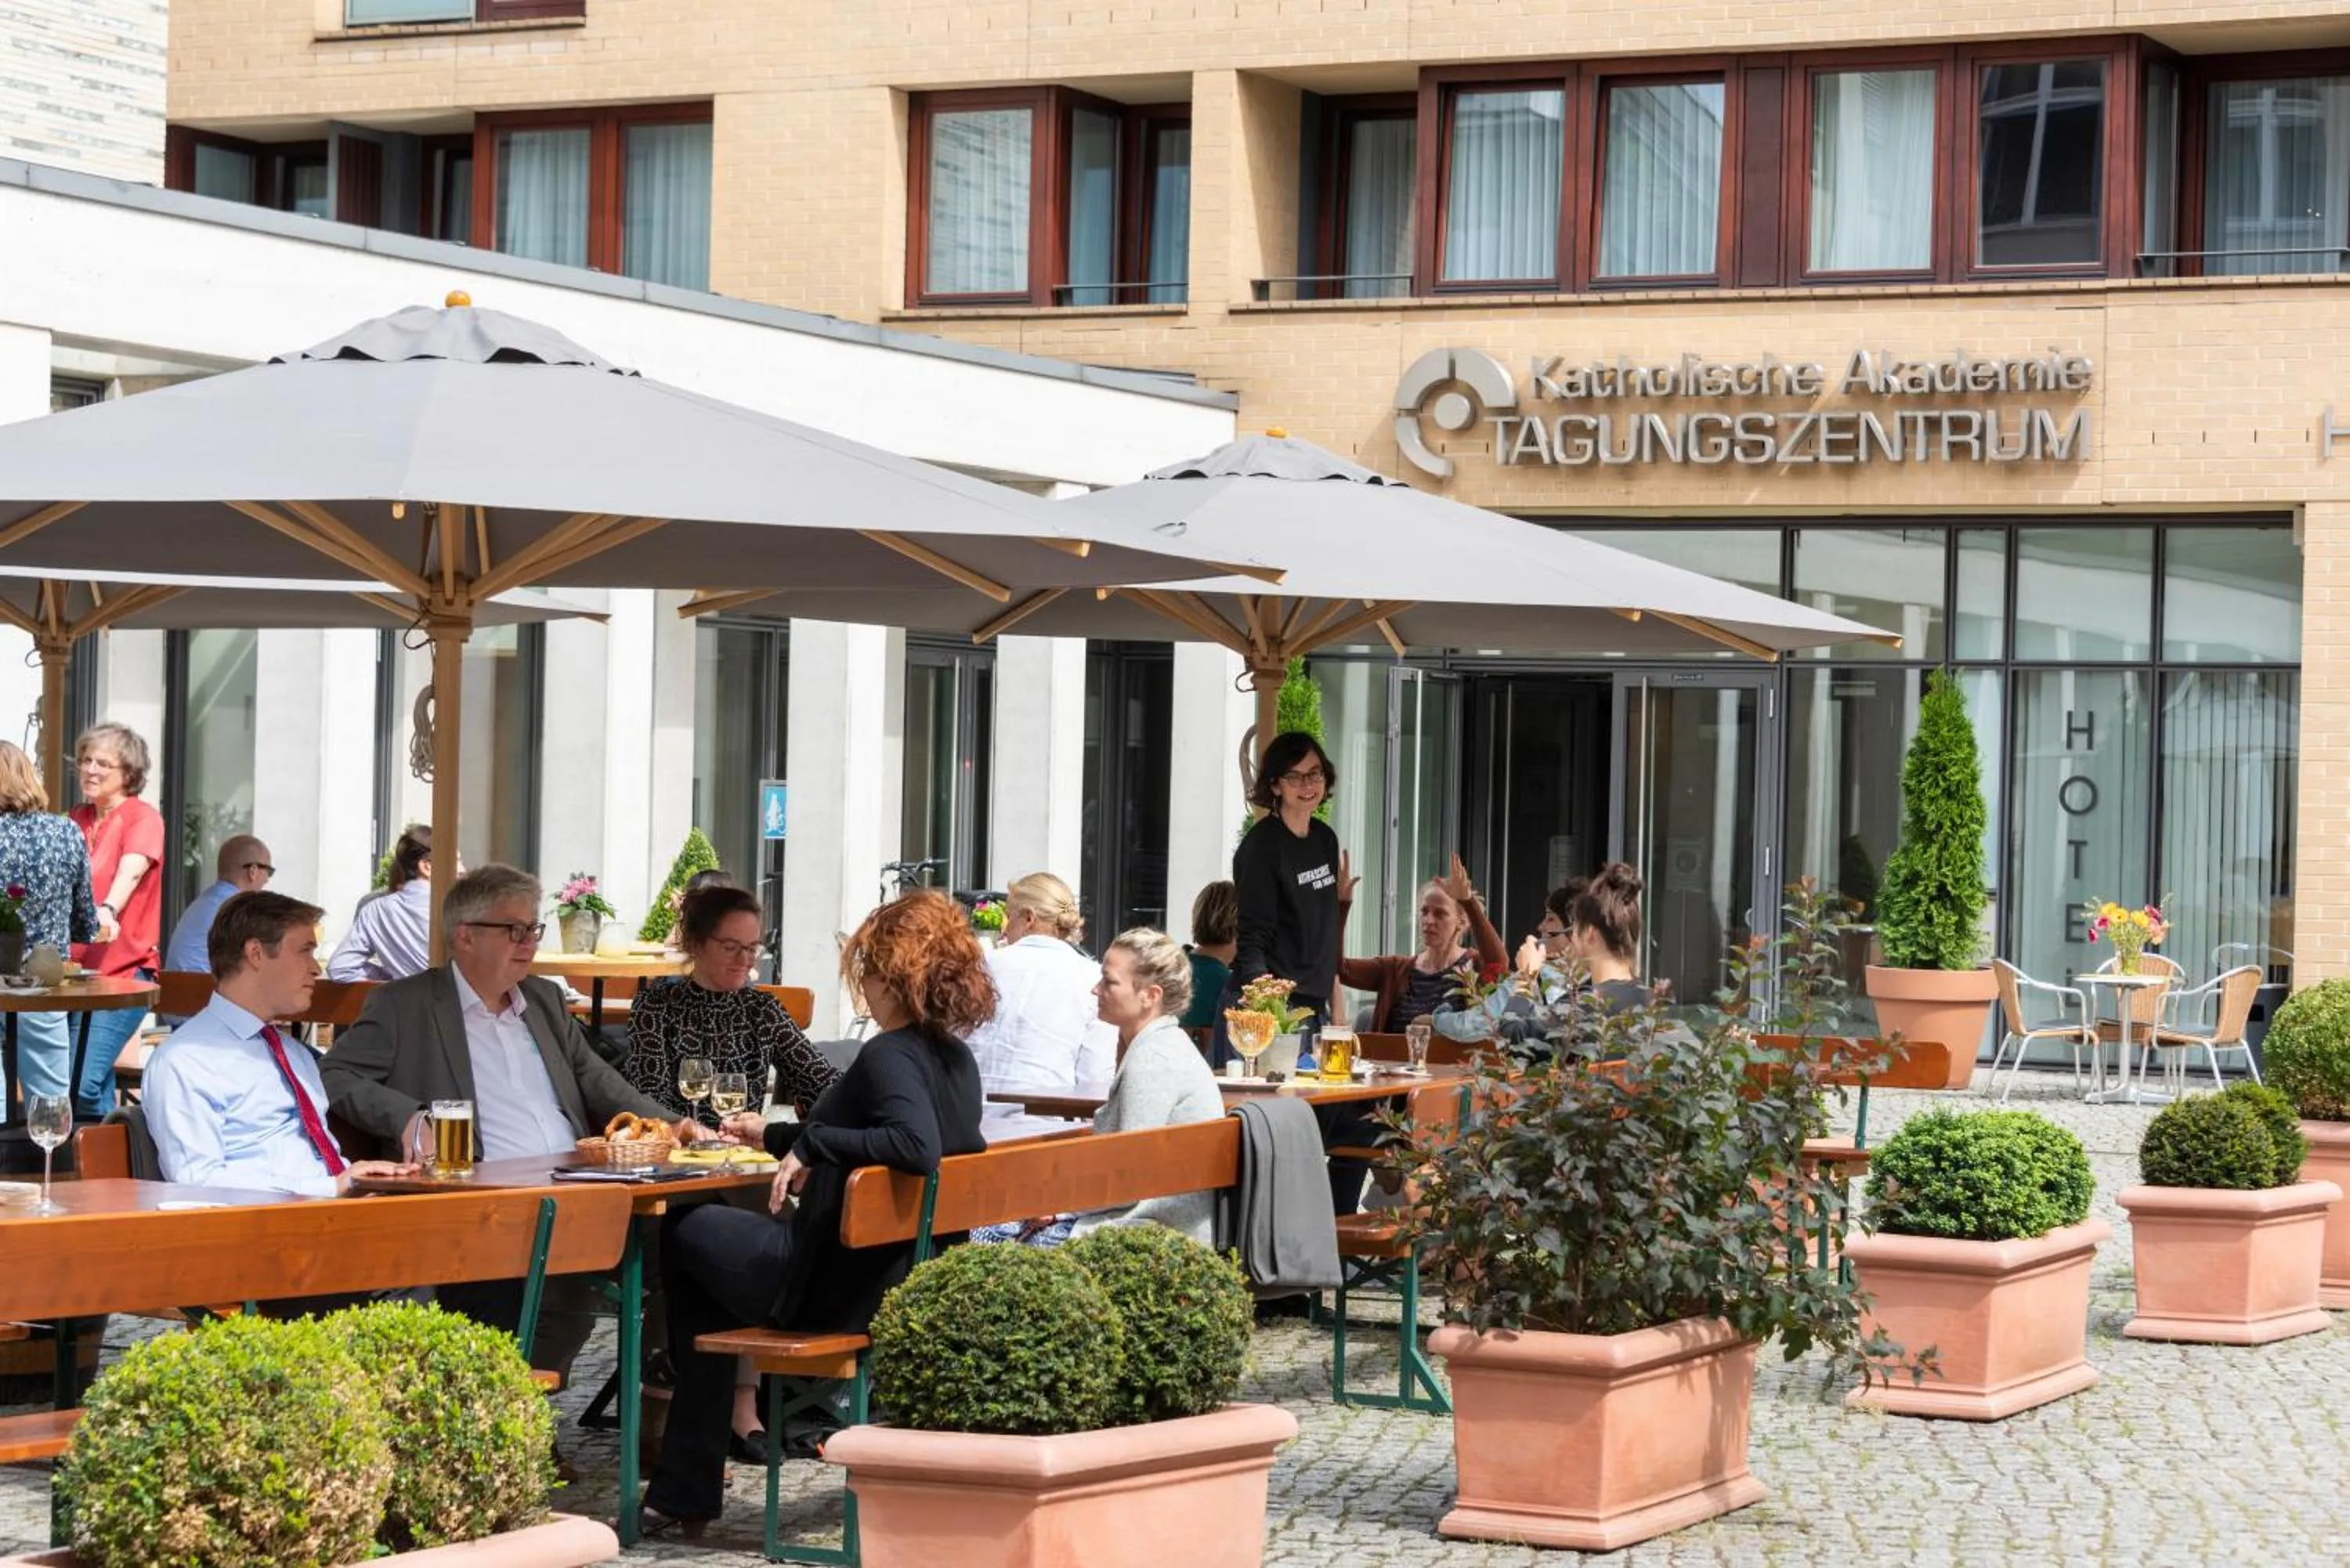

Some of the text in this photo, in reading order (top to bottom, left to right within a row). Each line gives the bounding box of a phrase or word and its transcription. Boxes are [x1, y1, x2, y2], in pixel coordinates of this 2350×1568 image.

[1530, 345, 2094, 399] Katholische Akademie
[1484, 408, 2093, 464] TAGUNGSZENTRUM
[2058, 710, 2098, 1008] HOTEL
